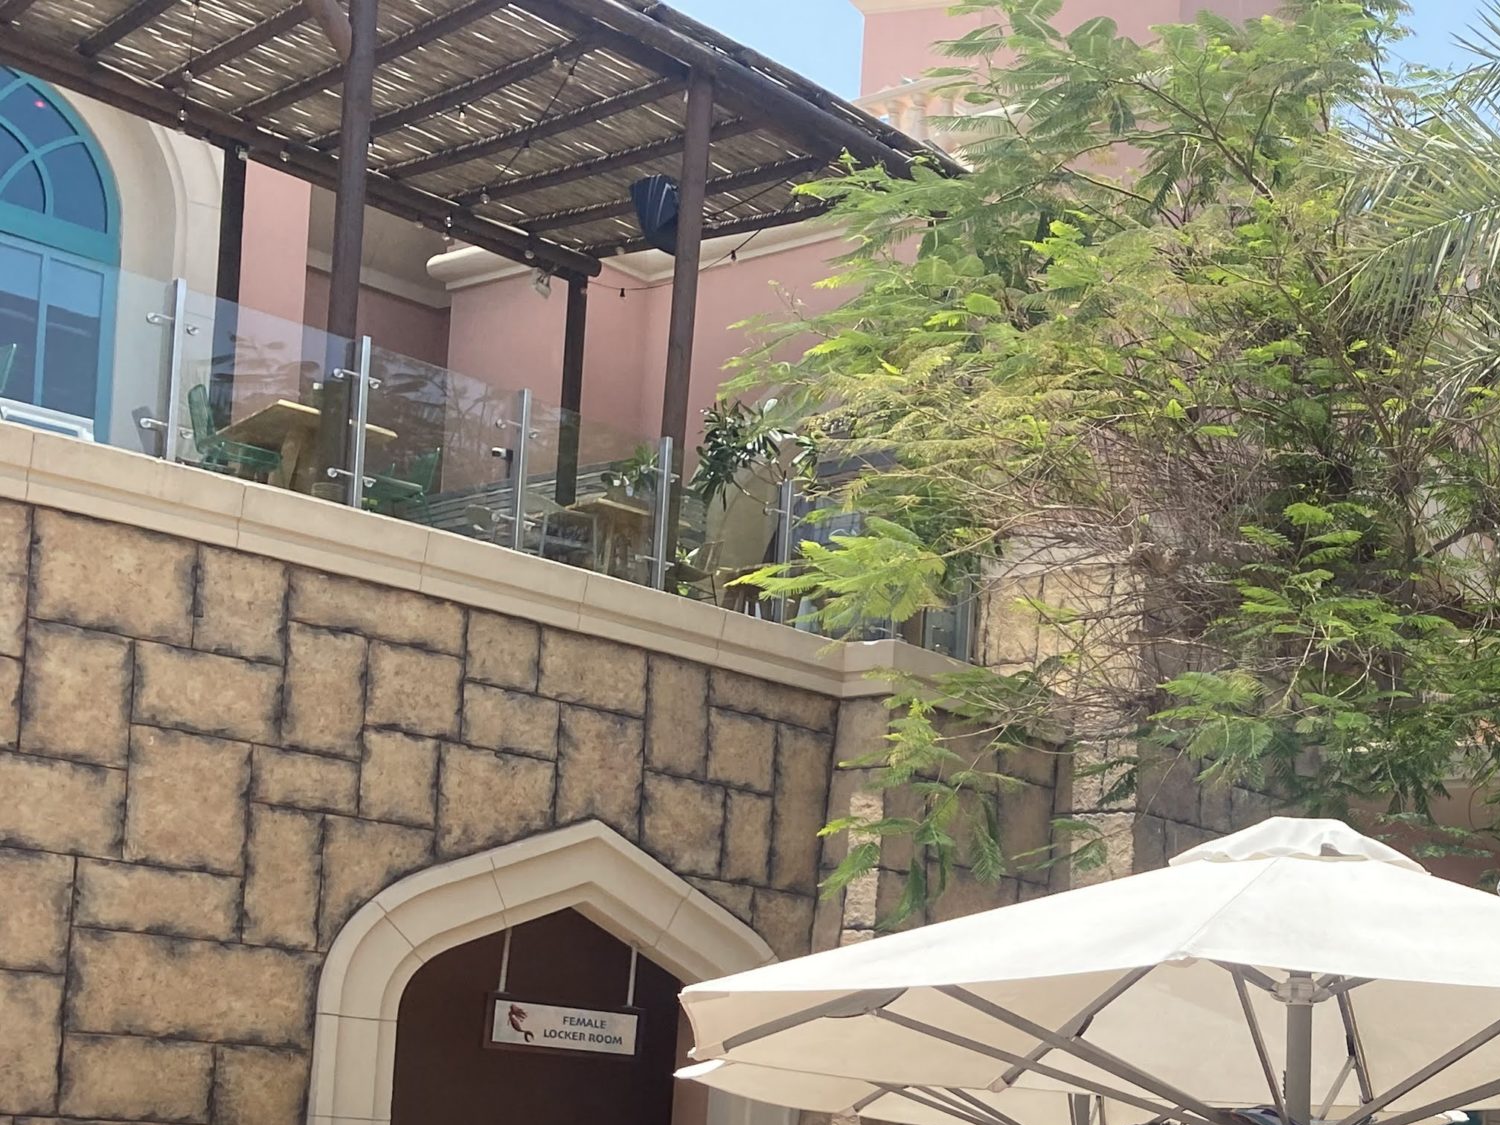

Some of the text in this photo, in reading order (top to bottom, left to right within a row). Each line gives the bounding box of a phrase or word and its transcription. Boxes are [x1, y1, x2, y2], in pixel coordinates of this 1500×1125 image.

[562, 1016, 608, 1030] FEMALE
[543, 1028, 623, 1045] LOCKER ROOM
